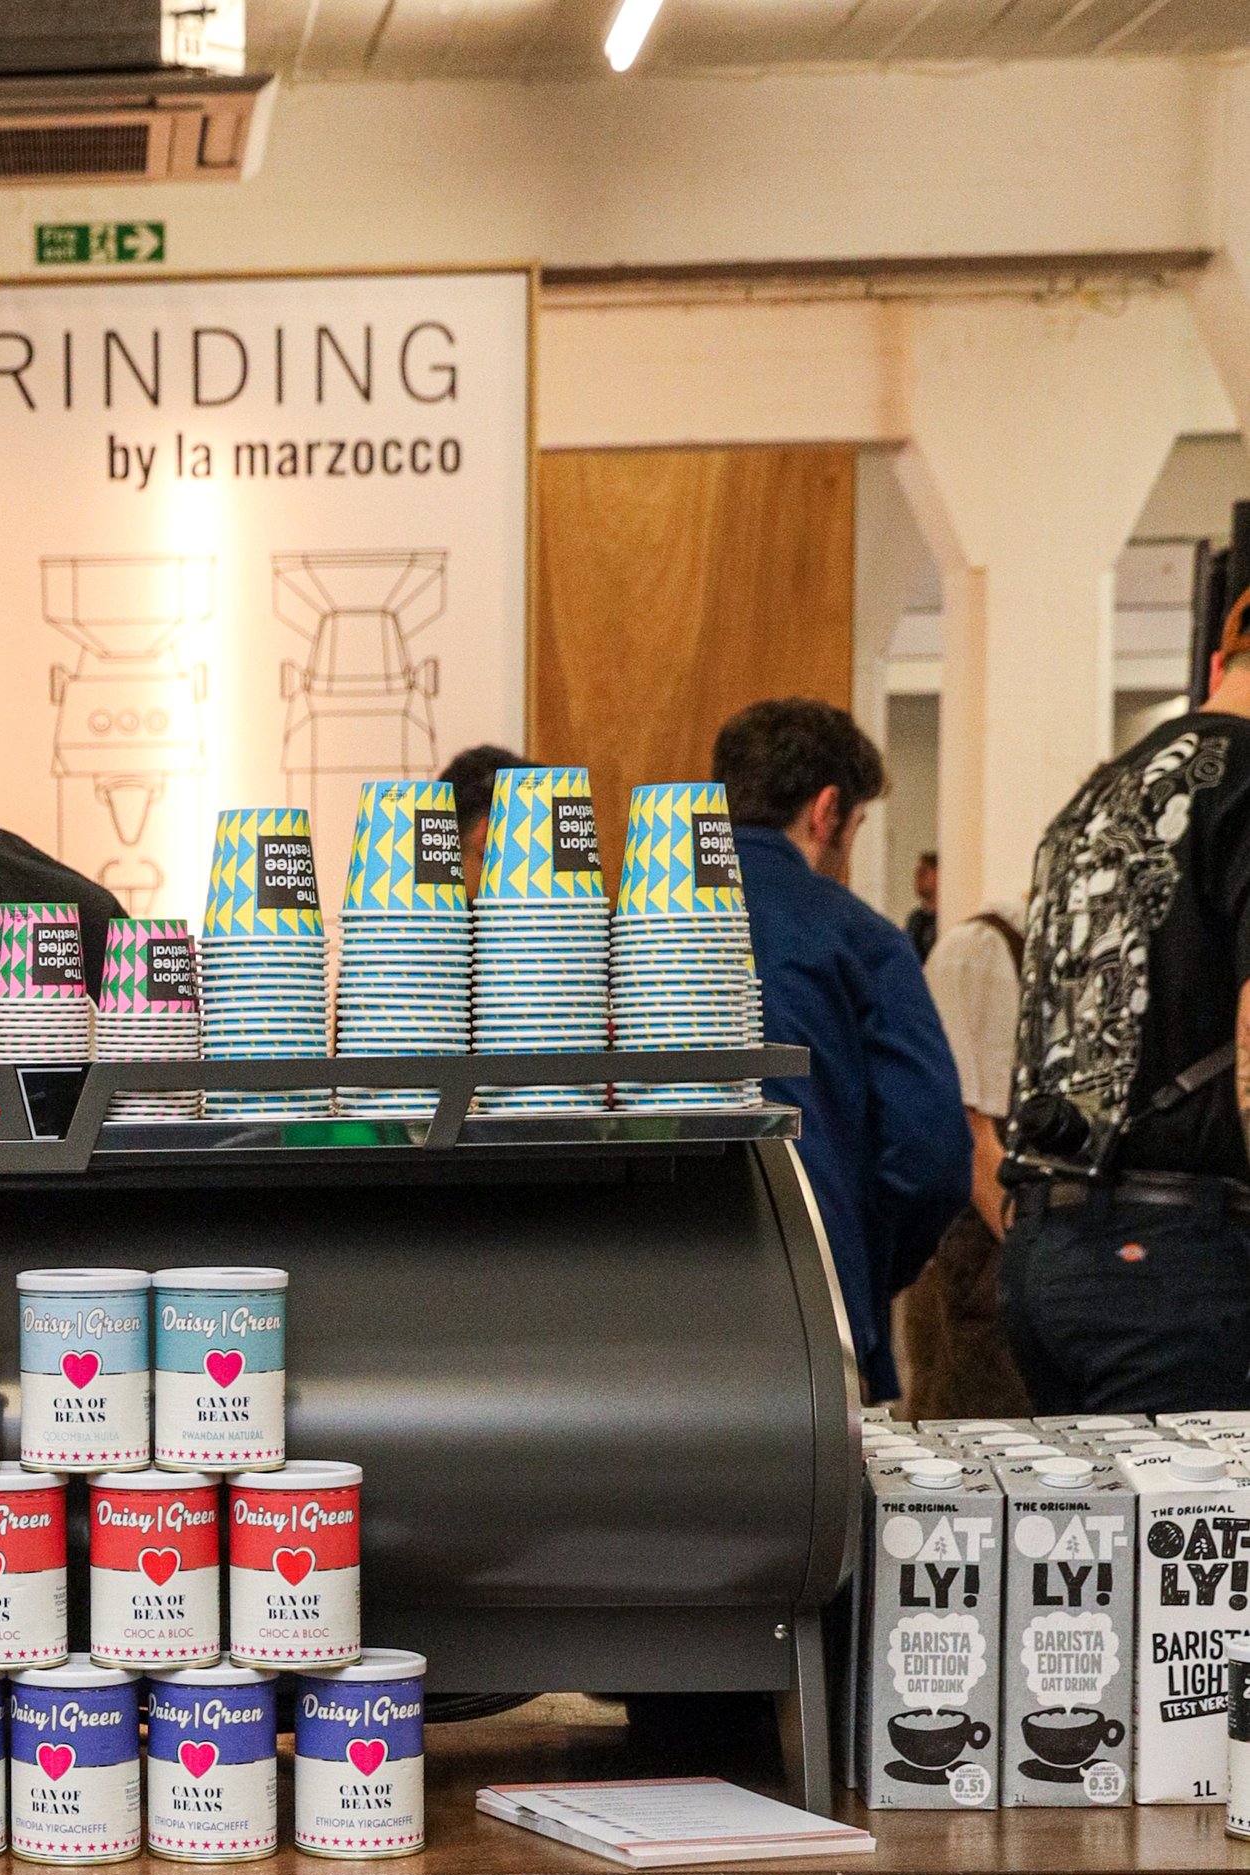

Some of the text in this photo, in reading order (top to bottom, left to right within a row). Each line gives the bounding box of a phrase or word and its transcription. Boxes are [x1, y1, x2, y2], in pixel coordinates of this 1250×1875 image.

[108, 432, 461, 489] by la marzocco
[265, 843, 310, 857] Festival
[265, 859, 313, 874] Coffee
[266, 876, 315, 889] London
[297, 891, 316, 904] The
[54, 1397, 107, 1409] CAN OF
[197, 1397, 251, 1407] CAN OF
[56, 1412, 105, 1422] BEANS
[199, 1411, 248, 1421] BEANS
[882, 1503, 958, 1513] THE ORIGINAL
[1014, 1502, 1091, 1512] THE ORIGINAL
[1151, 1505, 1235, 1518] THE ORIGINAL
[882, 1515, 996, 1561] OAT-
[1014, 1515, 1128, 1561] OAT-
[899, 1563, 979, 1608] LY!
[1033, 1562, 1113, 1607] LY!
[1160, 1561, 1248, 1611] LY!
[132, 1594, 186, 1606] CAN OF
[267, 1594, 321, 1606] CAN OF
[135, 1609, 184, 1619] BEANS
[269, 1609, 319, 1619] BEANS
[123, 1628, 155, 1639] CHOC
[168, 1627, 194, 1638] BLOC
[900, 1631, 971, 1653] BARISTA
[1034, 1630, 1105, 1652] BARISTA
[903, 1655, 969, 1676] EDITION
[1037, 1653, 1102, 1675] EDITION
[907, 1679, 964, 1693] OAT DRINK
[1041, 1677, 1098, 1692] OAT DRINK
[1163, 1701, 1198, 1719] TEST
[340, 1784, 393, 1795] CAN OF
[954, 1779, 985, 1793] 0.51
[1088, 1777, 1119, 1791] 0.51
[1193, 1780, 1217, 1797] 1L
[31, 1789, 82, 1801] CAN OF
[172, 1786, 224, 1798] CAN OF
[33, 1802, 79, 1814] BEANS
[174, 1800, 222, 1811] BEANS
[342, 1799, 391, 1809] BEANS
[315, 1815, 413, 1829] ETHIOPIA YIRGACHEFFE
